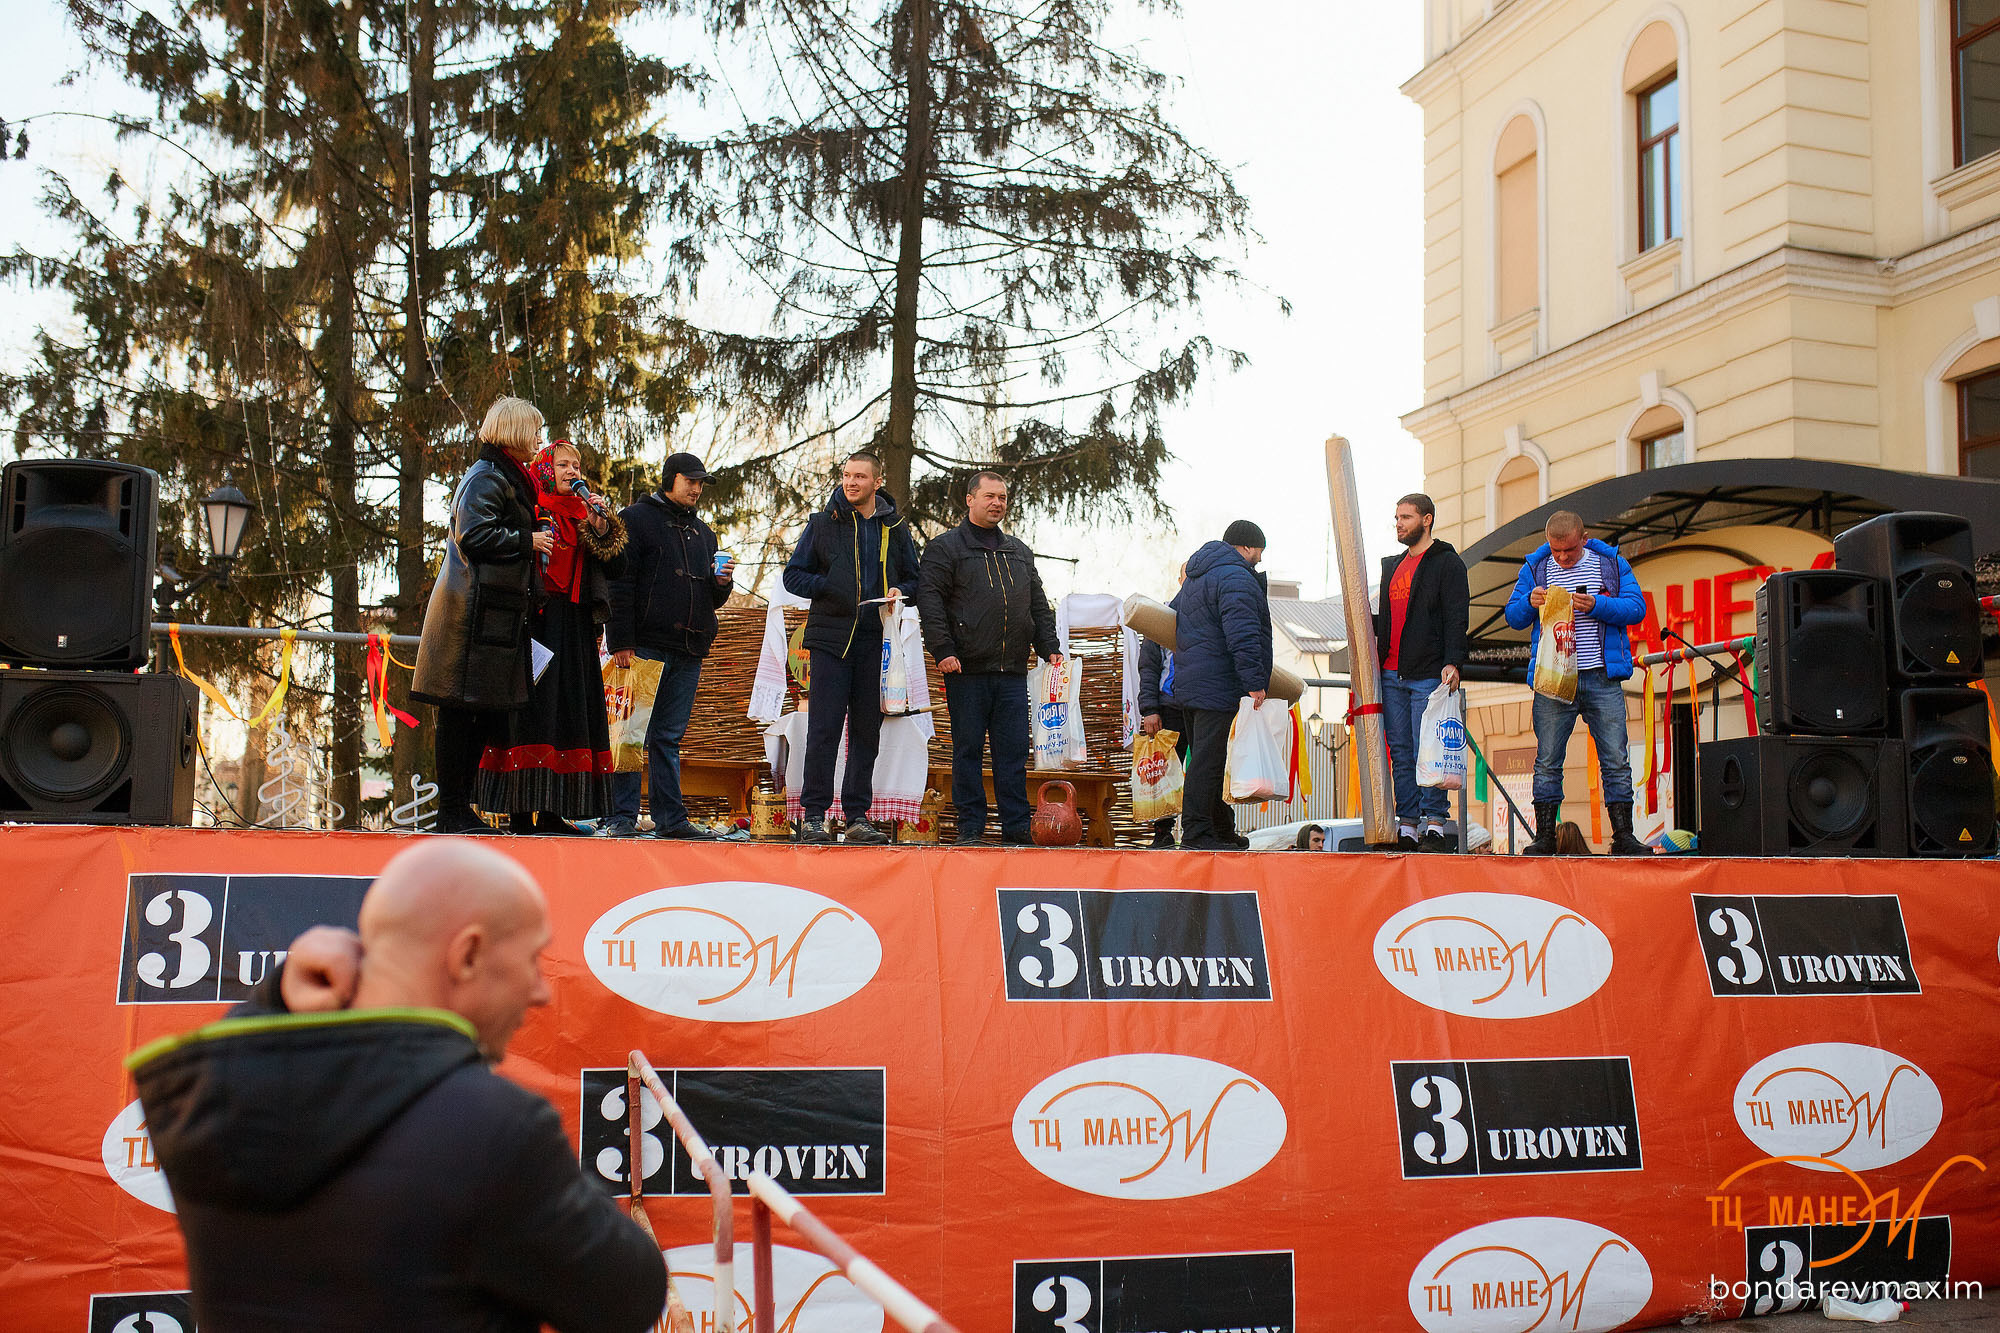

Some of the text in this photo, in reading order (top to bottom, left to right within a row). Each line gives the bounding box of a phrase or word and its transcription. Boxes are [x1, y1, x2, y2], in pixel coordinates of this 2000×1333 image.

[137, 889, 213, 989] 3
[602, 939, 636, 972] ТЦ
[1016, 902, 1254, 988] 3 UROVEN
[1708, 907, 1906, 985] 3 UROVEN
[1387, 947, 1418, 977] ТЦ
[1410, 1075, 1627, 1165] 3 UROVEN
[1746, 1100, 1774, 1131] ТЦ
[1029, 1118, 1061, 1152] ТЦ
[1424, 1284, 1453, 1316] ТЦ
